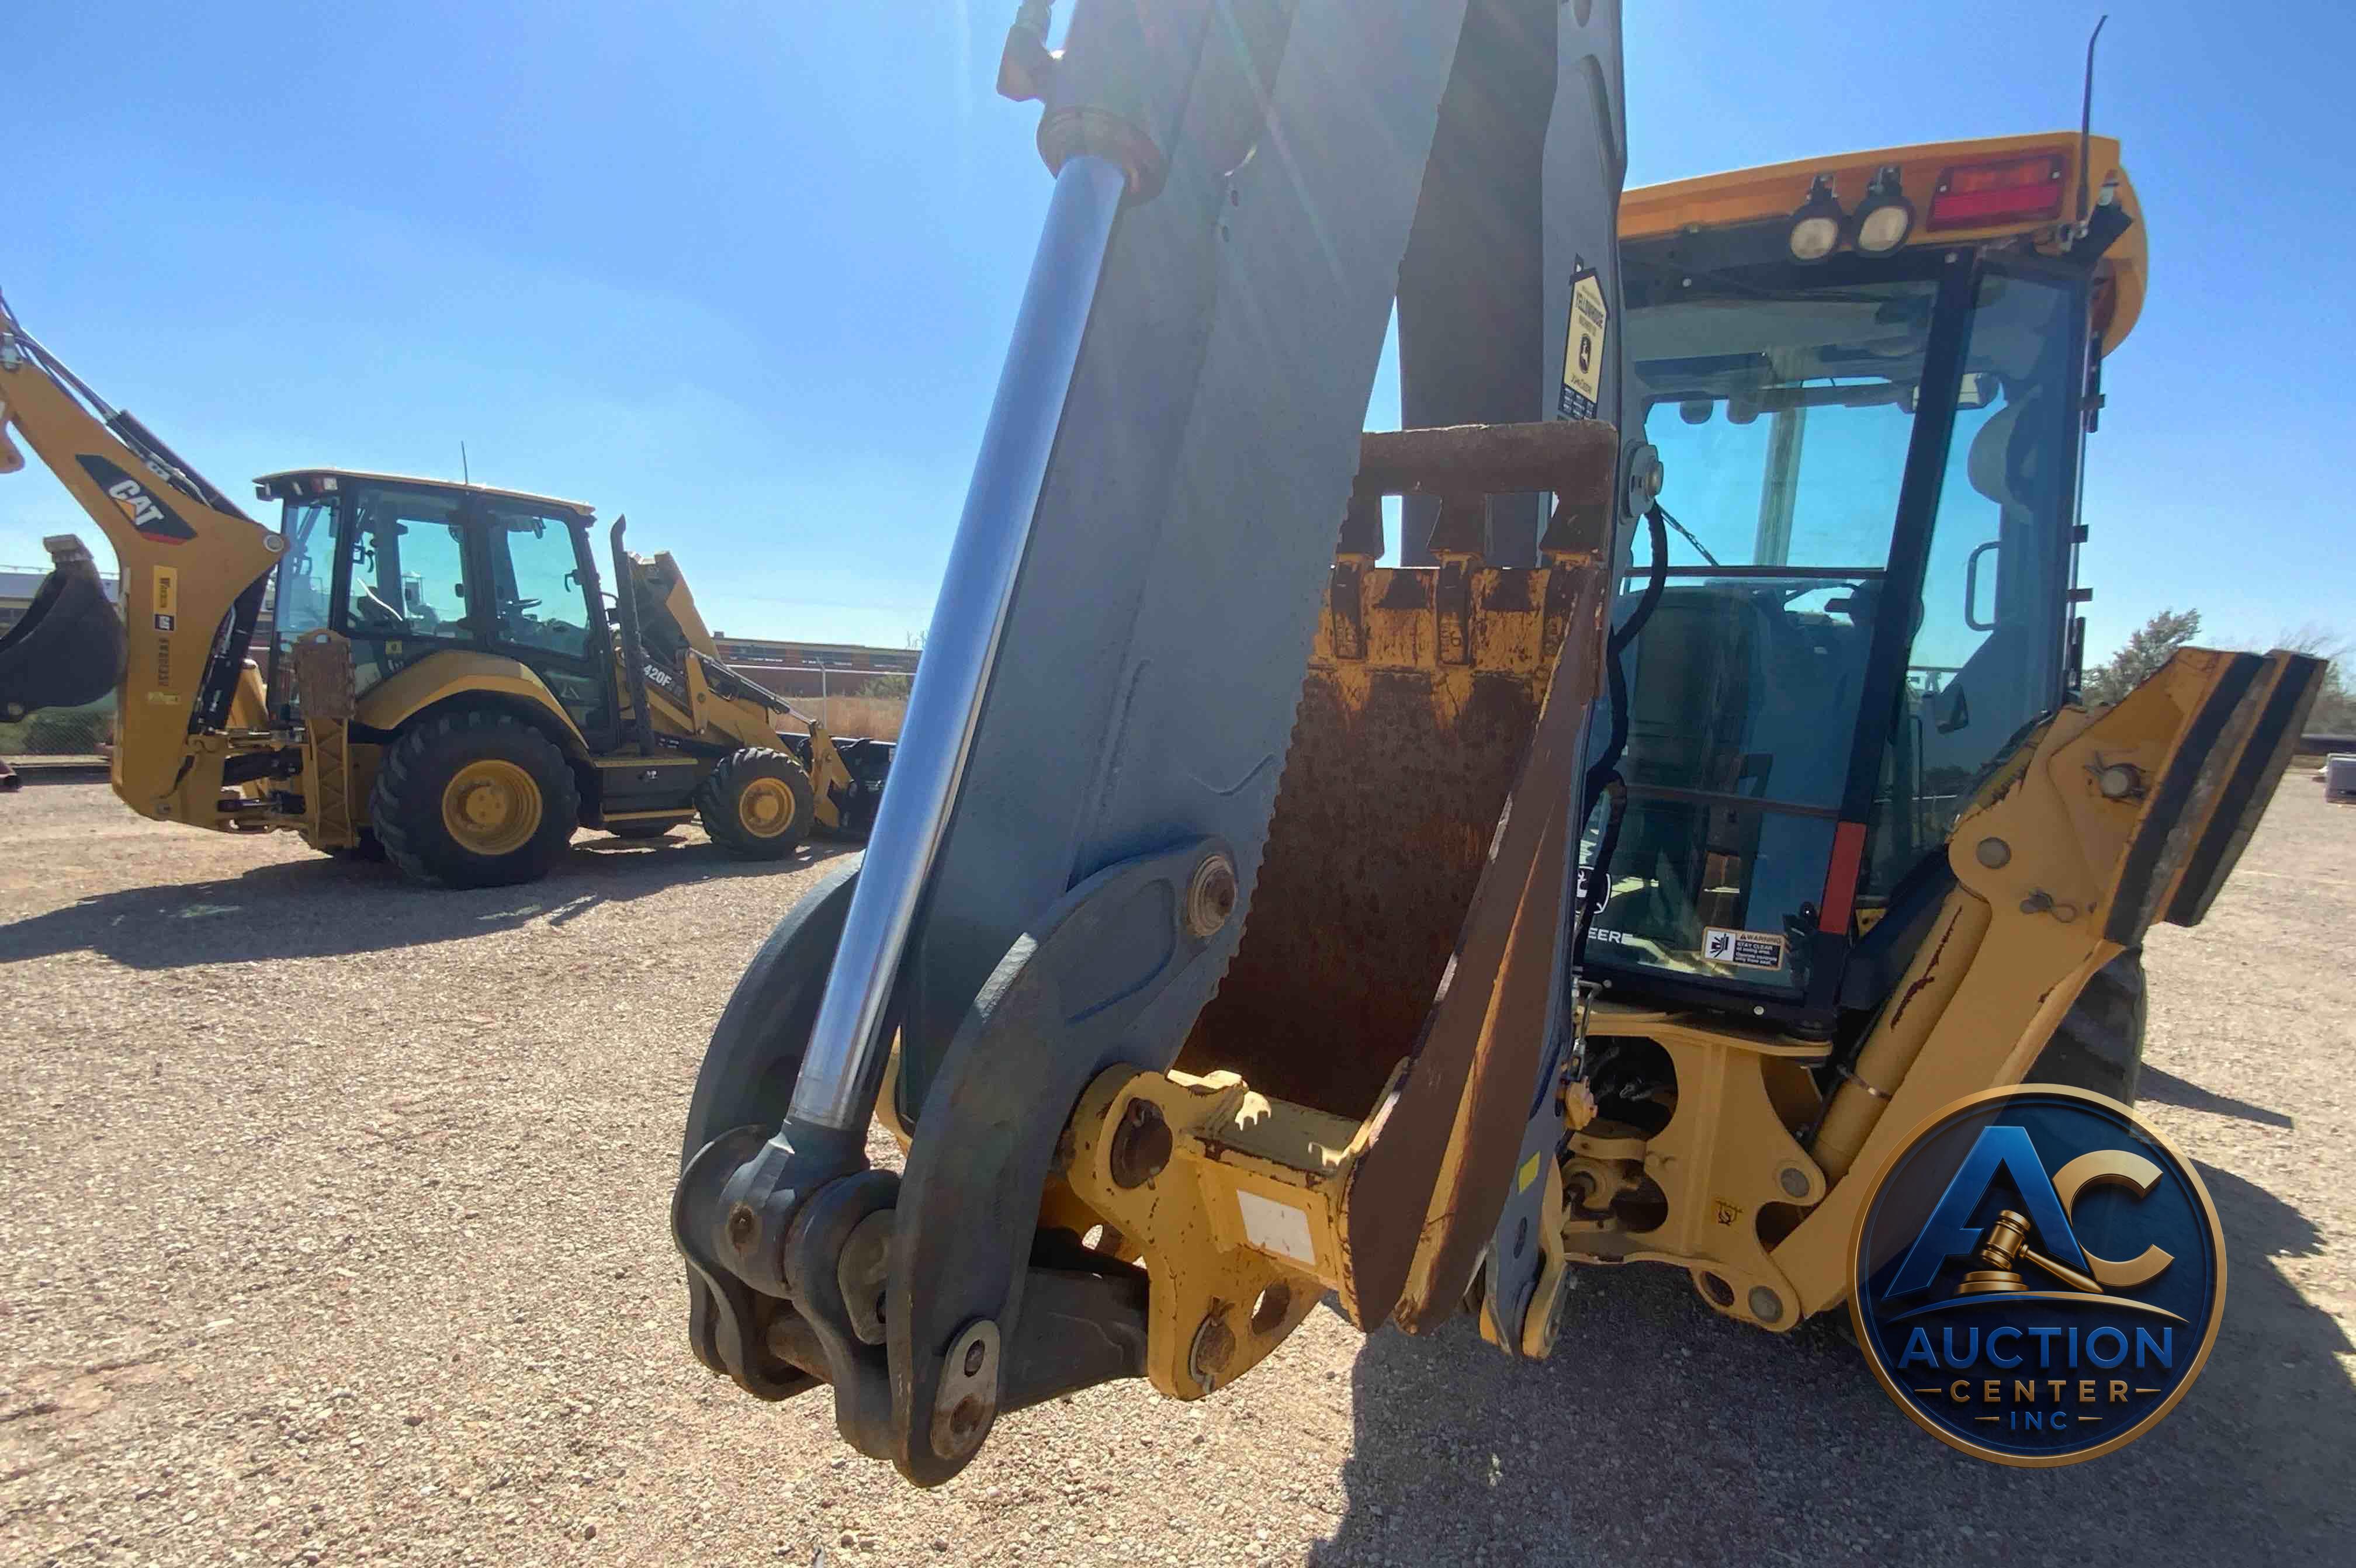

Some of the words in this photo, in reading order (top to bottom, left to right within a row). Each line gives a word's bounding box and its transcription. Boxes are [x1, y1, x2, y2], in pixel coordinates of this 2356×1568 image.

[109, 479, 165, 526] CAT
[1588, 927, 1633, 945] EERE
[1747, 935, 1782, 943] WARNING
